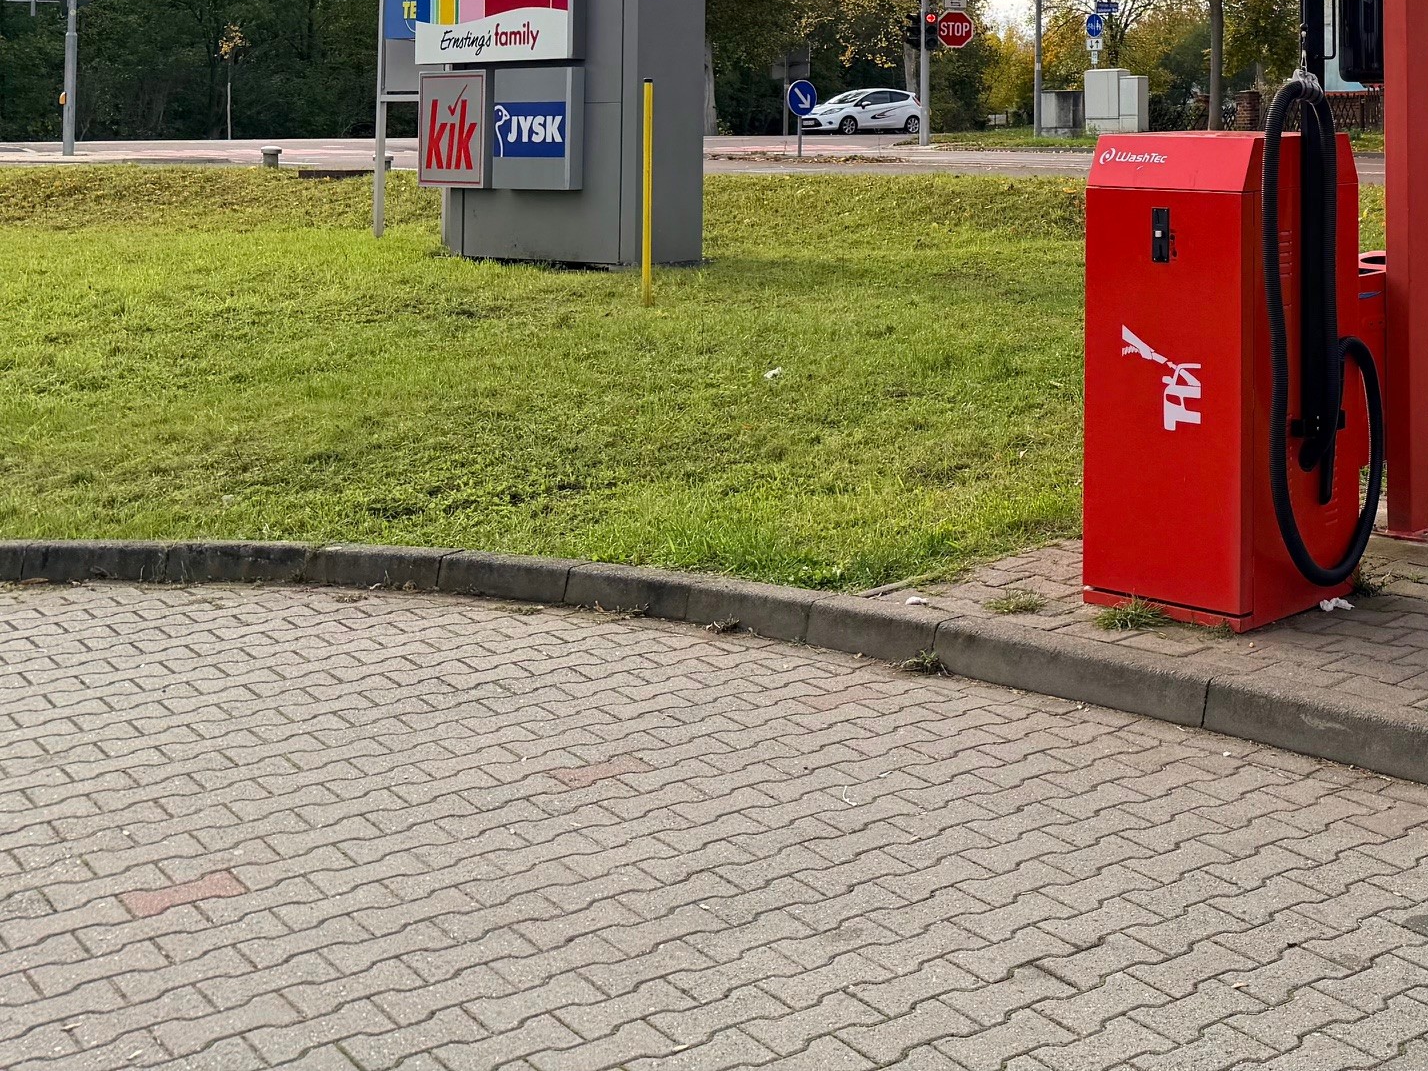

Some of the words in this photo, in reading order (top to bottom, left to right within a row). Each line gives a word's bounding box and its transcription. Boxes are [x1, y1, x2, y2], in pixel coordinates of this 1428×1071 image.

[440, 29, 492, 57] Ernsting's
[494, 21, 540, 51] family
[940, 21, 970, 37] STOP
[507, 115, 563, 144] JYSK
[1115, 150, 1168, 164] WashTec
